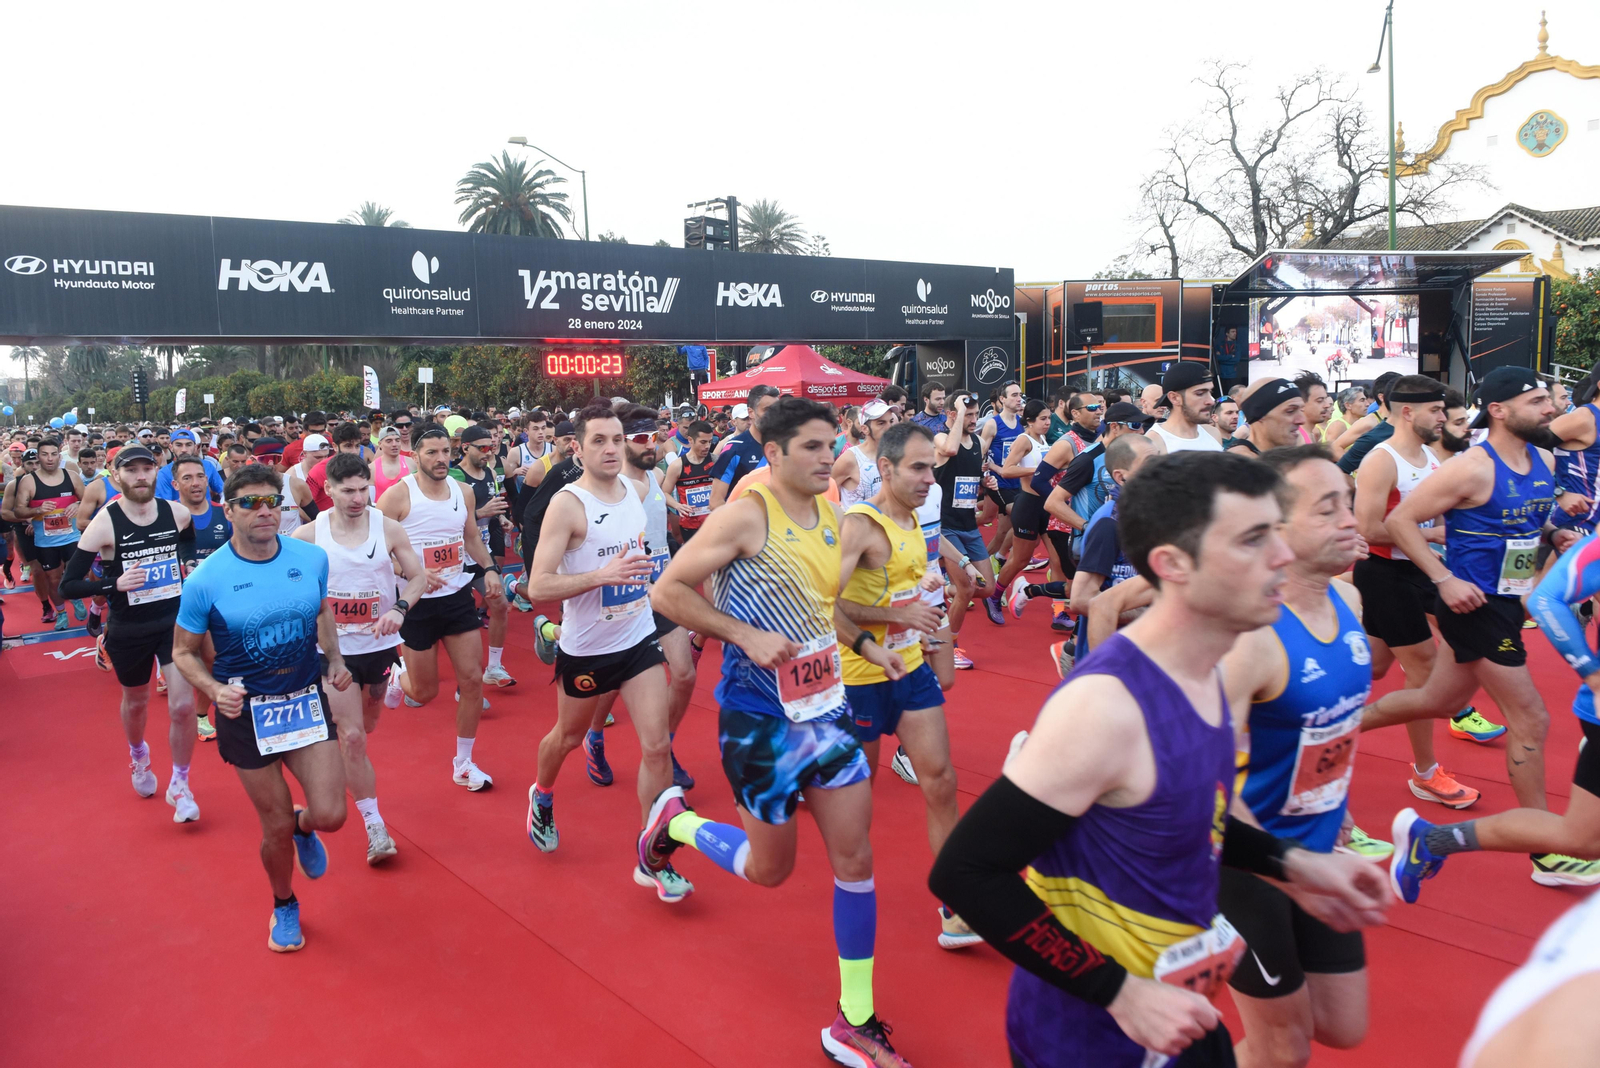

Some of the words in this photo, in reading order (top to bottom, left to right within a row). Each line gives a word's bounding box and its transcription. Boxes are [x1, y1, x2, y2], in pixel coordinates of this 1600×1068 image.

[52, 258, 154, 276] HYUNDAI
[218, 258, 332, 292] HOKA
[54, 278, 119, 290] Hyundauto
[122, 280, 155, 290] Motor
[551, 270, 658, 292] maratón
[1085, 283, 1119, 292] portos
[382, 286, 471, 303] quirónsalud
[582, 290, 658, 313] sevilla
[716, 282, 783, 308] HOKA
[830, 292, 876, 303] HYUNDAI
[391, 306, 432, 316] Healthcare
[436, 307, 464, 316] Partner
[901, 304, 948, 316] quirónsalud
[568, 318, 581, 329] 28
[584, 320, 615, 330] enero
[618, 320, 643, 330] 2024
[546, 355, 623, 374] 00:00:23
[434, 548, 452, 562] 931
[333, 602, 367, 616] 1440
[259, 618, 304, 649] RUA
[790, 654, 831, 686] 1204
[263, 702, 304, 727] 2771
